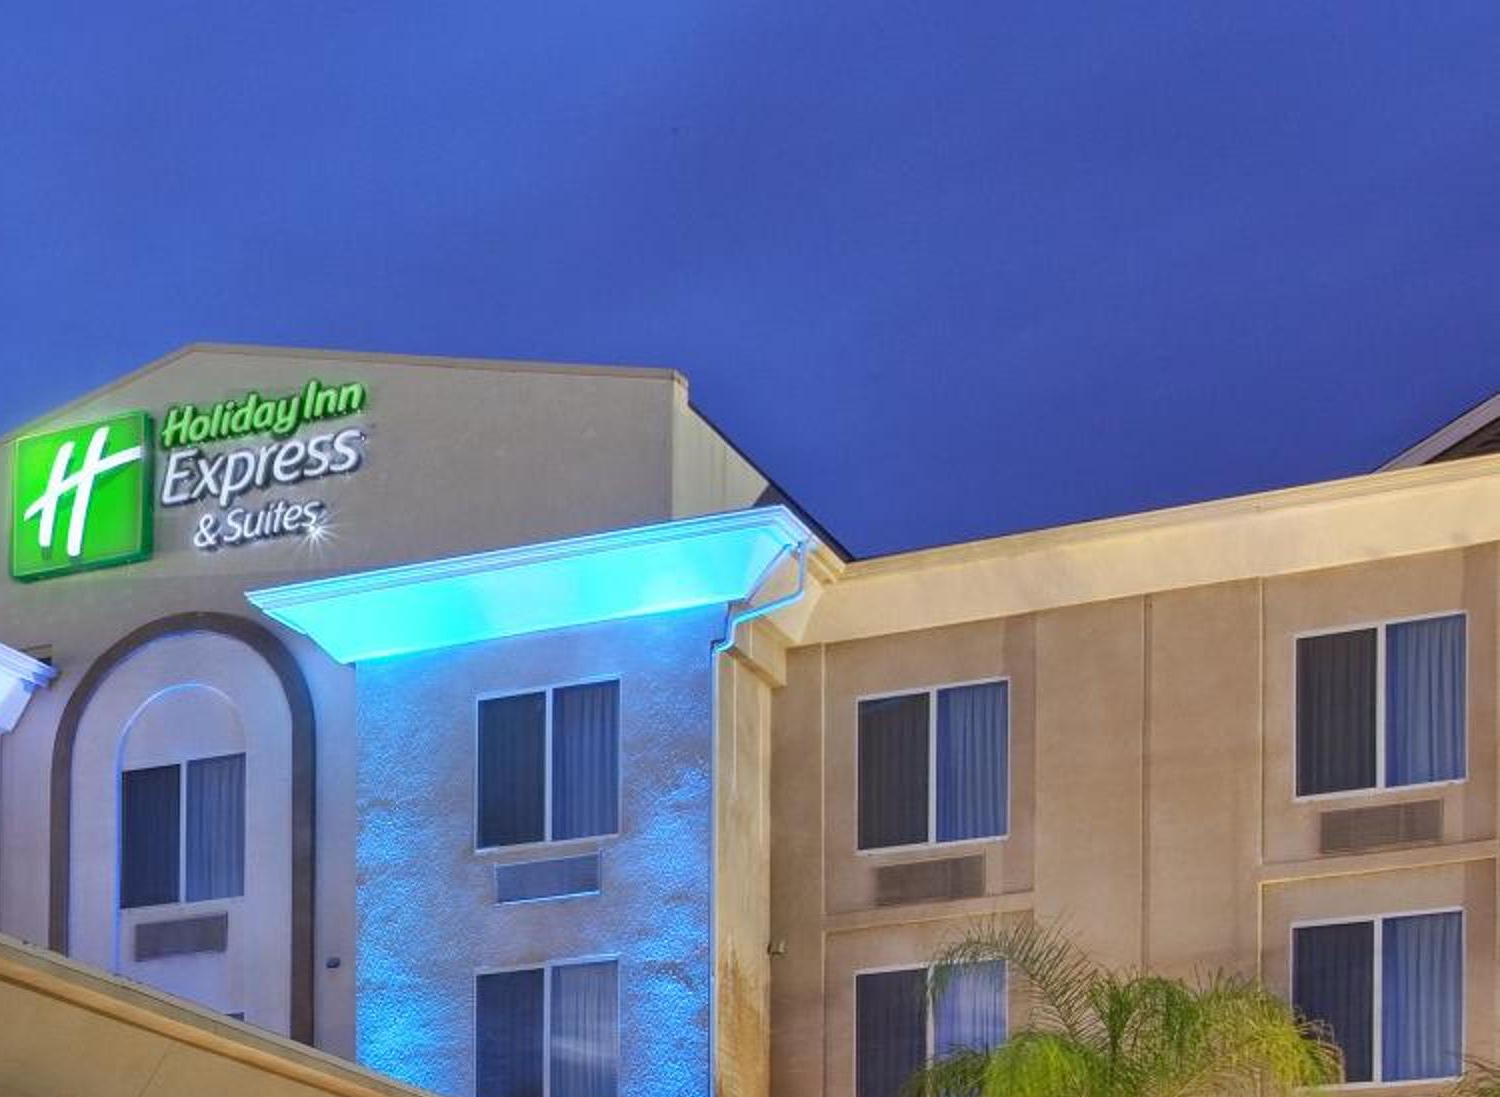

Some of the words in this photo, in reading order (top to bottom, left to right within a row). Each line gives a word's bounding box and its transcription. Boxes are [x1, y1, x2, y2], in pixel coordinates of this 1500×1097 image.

[162, 393, 300, 447] Holiday
[303, 381, 363, 418] Inn
[24, 426, 143, 557] H
[162, 429, 362, 507] Express
[193, 513, 221, 547] &
[223, 501, 322, 543] Suites
